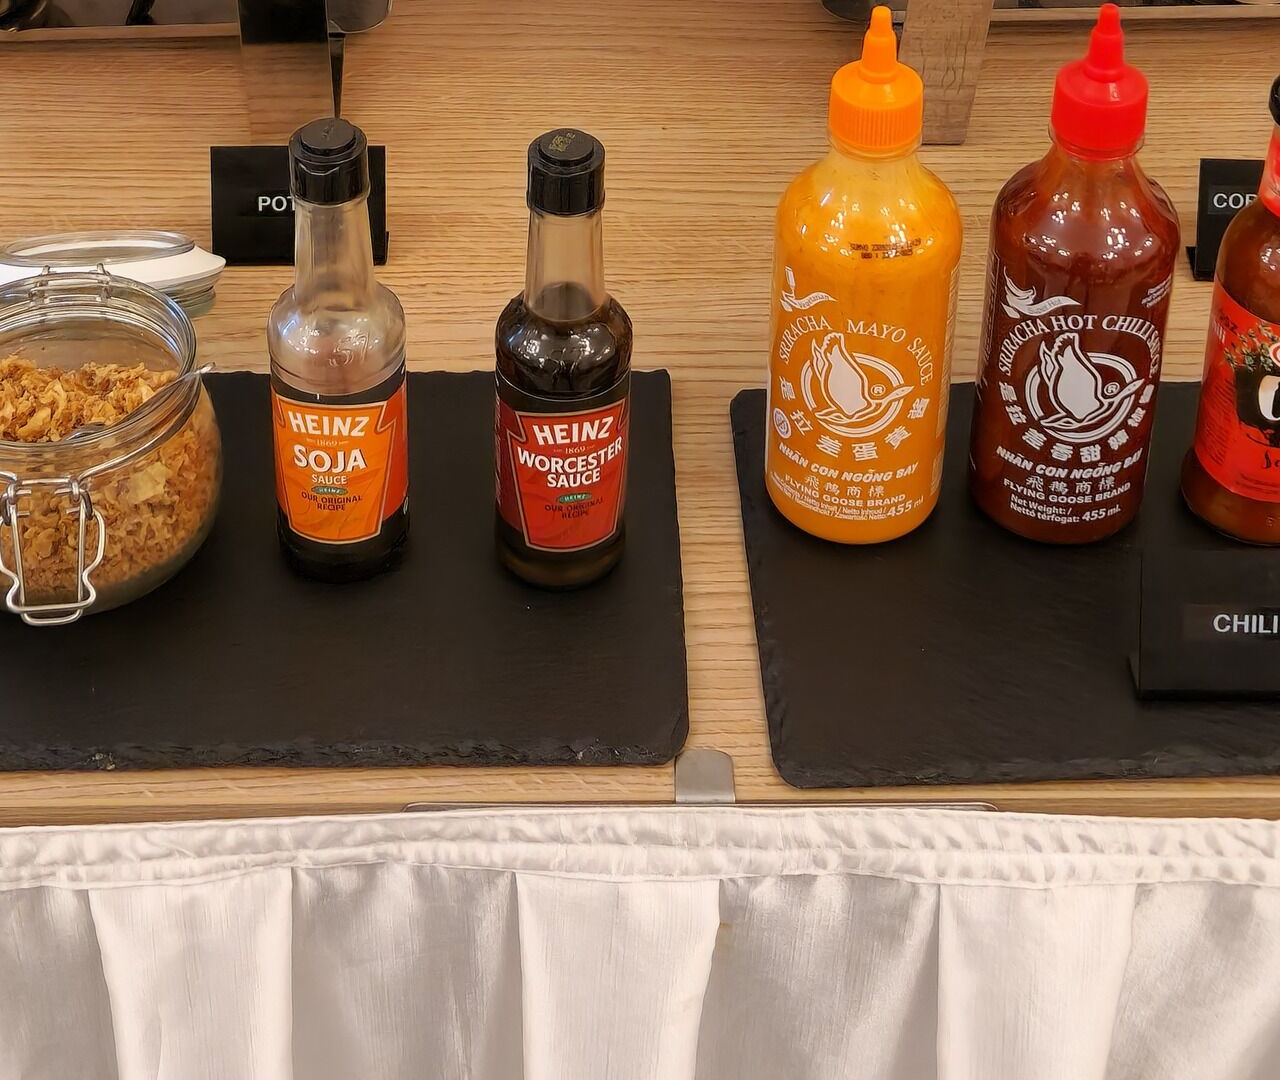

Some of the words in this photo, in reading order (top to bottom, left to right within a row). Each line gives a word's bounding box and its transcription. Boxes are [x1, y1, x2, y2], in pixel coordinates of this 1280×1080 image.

[258, 195, 296, 212] POT
[778, 315, 833, 365] SRIRACHA
[846, 319, 907, 344] MAYO
[907, 336, 934, 386] SAUCE
[998, 318, 1051, 377] SRIRACHA
[1050, 315, 1098, 331] HOT
[1102, 315, 1155, 342] CHILLI
[287, 410, 370, 438] HEINZ
[532, 416, 614, 446] HEINZ
[316, 439, 338, 447] 1869
[565, 446, 586, 455] 1869
[293, 443, 368, 474] SOJA
[517, 436, 623, 474] WORCESTER
[778, 442, 809, 469] NHÃN
[810, 463, 839, 479] CON
[895, 462, 919, 479] BAY
[996, 445, 1034, 471] NHÃN
[1035, 463, 1068, 479] CON
[1122, 447, 1144, 469] BAY
[311, 474, 348, 485] SAUCE
[547, 468, 601, 489] SAUCE
[301, 492, 319, 503] OUR
[321, 495, 362, 505] ORIGINAL
[784, 473, 820, 499] FLYING
[822, 494, 865, 508] GOOSE
[866, 493, 907, 508] BRAND
[1003, 478, 1046, 501] FLYING
[1048, 493, 1093, 504] GOOSE
[1095, 482, 1132, 502] BRAND
[317, 503, 346, 512] RECIPE
[544, 504, 563, 513] OUR
[886, 499, 913, 518] 455
[1010, 493, 1028, 507] Net
[1027, 500, 1067, 516] Weight:
[1010, 502, 1036, 519] Nettó
[1081, 507, 1107, 522] 455
[1213, 614, 1279, 634] CHILI
